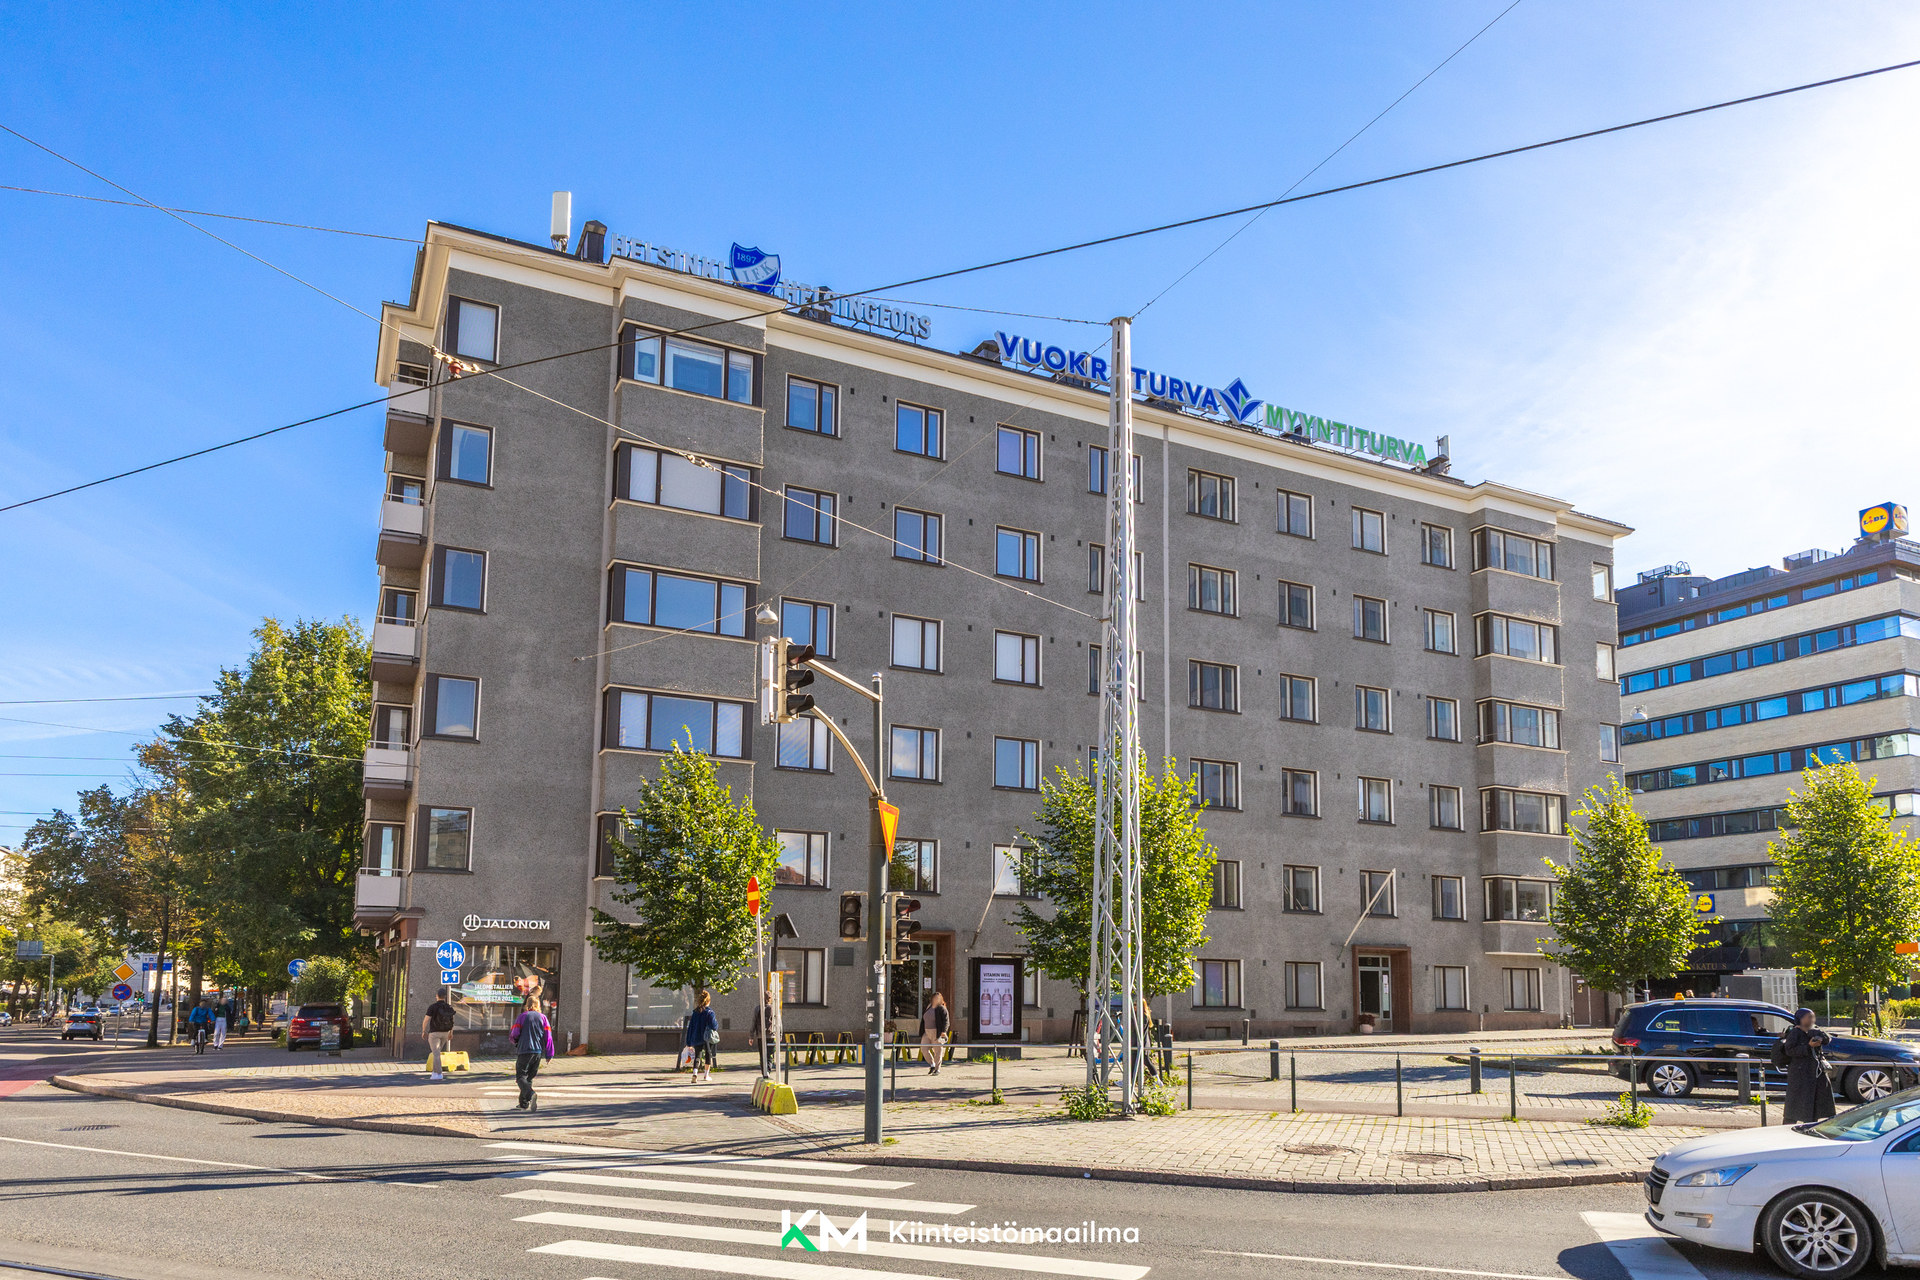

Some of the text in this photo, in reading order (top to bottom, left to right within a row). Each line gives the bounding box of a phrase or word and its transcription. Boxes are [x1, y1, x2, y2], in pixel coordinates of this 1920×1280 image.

[611, 232, 725, 279] HELSINKI
[736, 252, 757, 264] 1897
[782, 278, 932, 340] HELSINGFORS
[994, 330, 1220, 415] VUOKRTURVA
[1263, 403, 1429, 469] MYYNTITURVA
[483, 919, 550, 930] JALONOM
